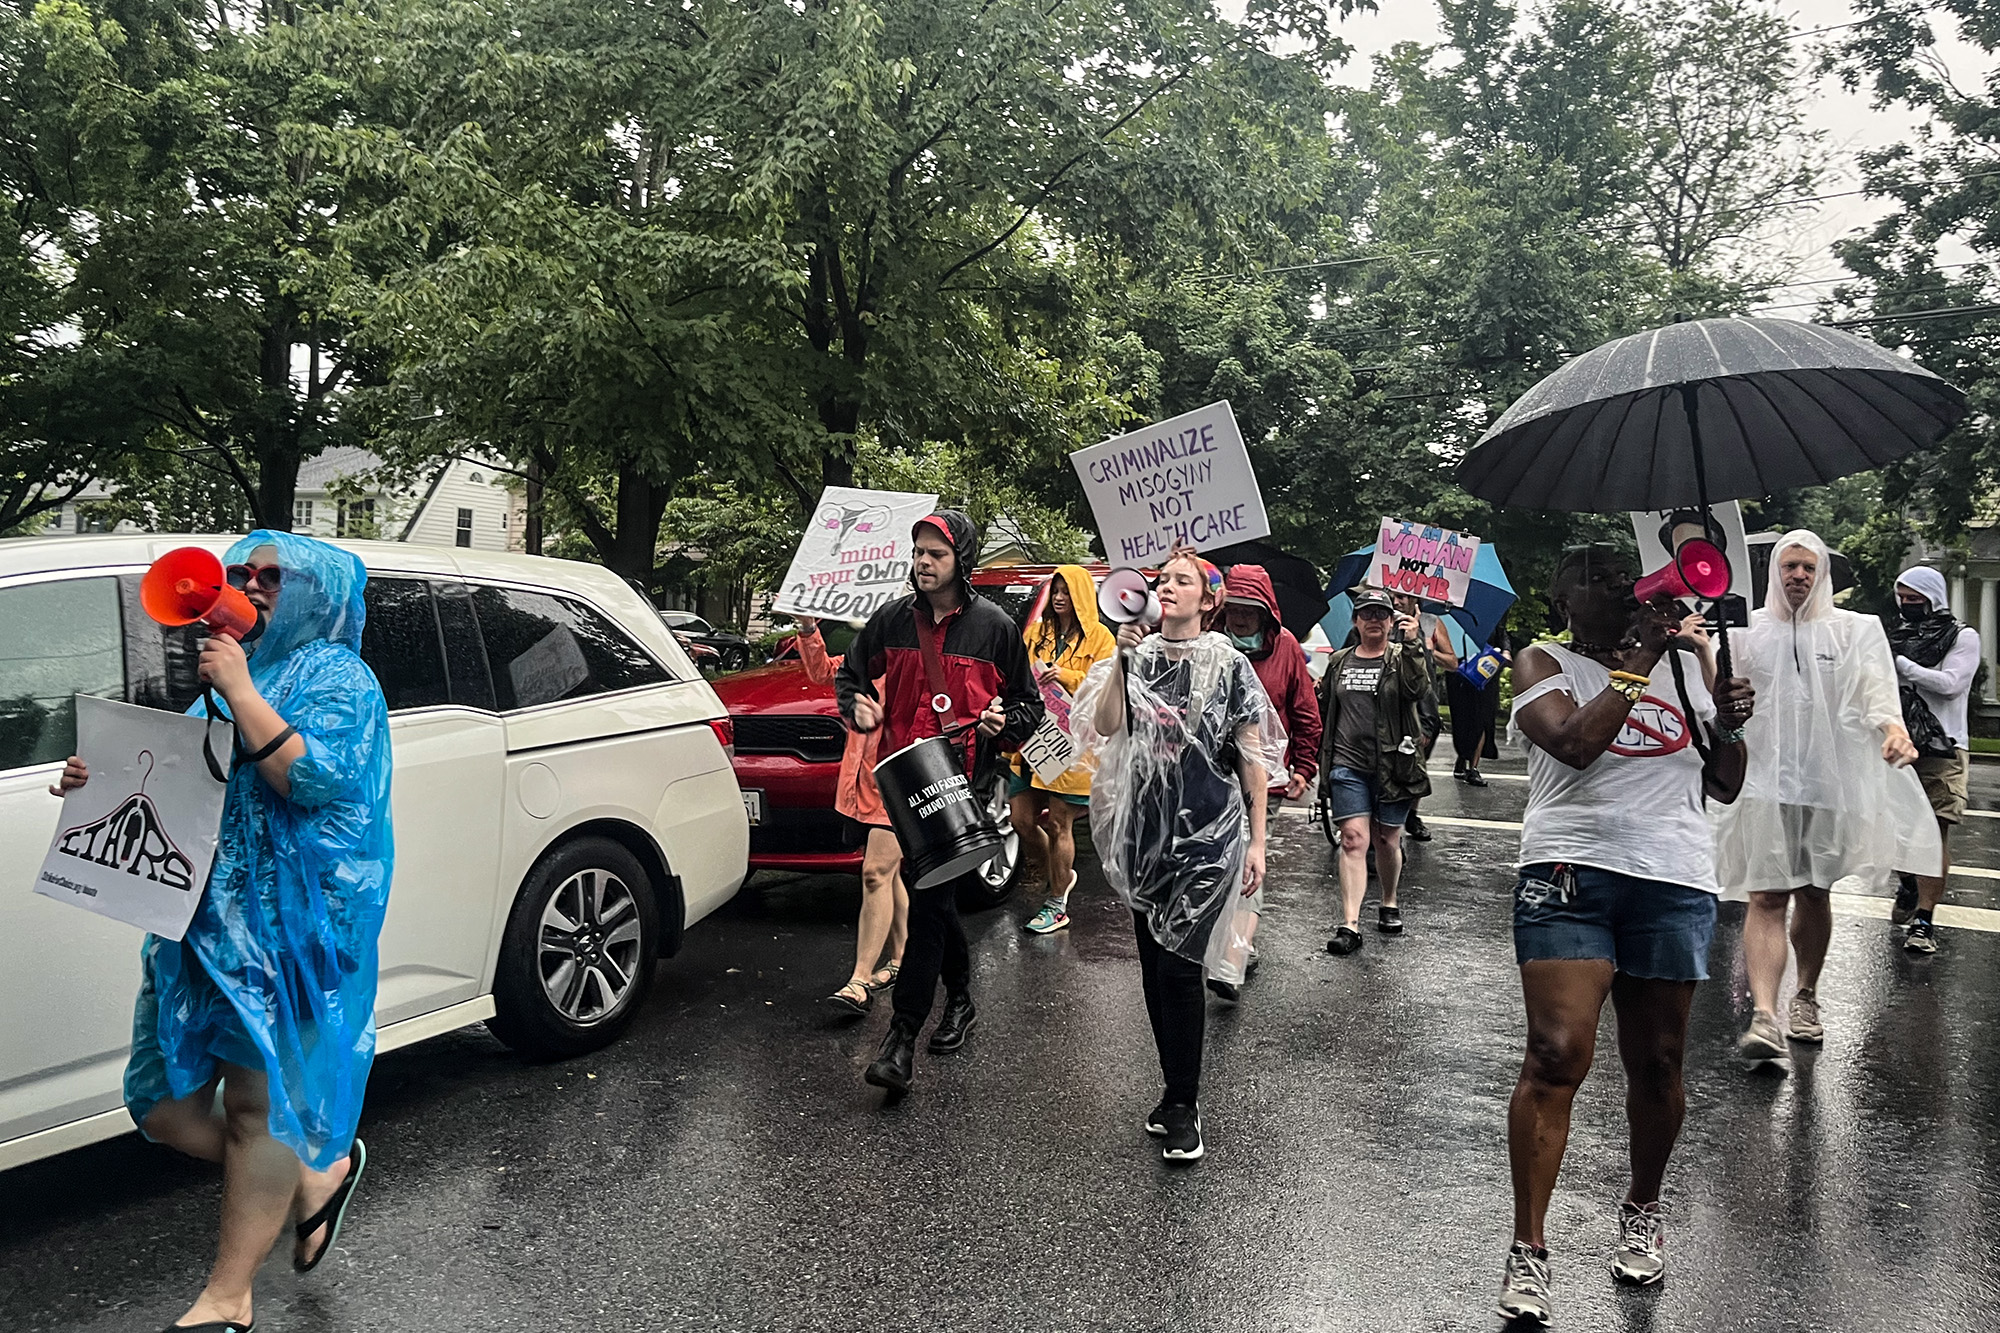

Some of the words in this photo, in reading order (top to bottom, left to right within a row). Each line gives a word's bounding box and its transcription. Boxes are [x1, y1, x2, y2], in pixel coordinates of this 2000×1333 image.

[1089, 424, 1218, 483] CRIMINALIZE
[1119, 458, 1211, 506] MISOGYNY
[1149, 490, 1194, 523] NOT
[1121, 503, 1247, 560] HEALTHCARE
[1400, 521, 1414, 535] I
[1421, 525, 1443, 541] AM
[1447, 532, 1458, 546] A
[839, 541, 895, 565] mind
[1382, 528, 1473, 573] WOMAN
[808, 569, 855, 591] your
[1382, 564, 1450, 600] WOMB
[1399, 557, 1429, 574] NOT
[1433, 565, 1443, 578] A
[908, 793, 924, 808] ALL
[922, 783, 940, 798] YOU
[918, 796, 946, 819] BOUND
[944, 792, 957, 805] TO
[954, 788, 973, 801] LOSE
